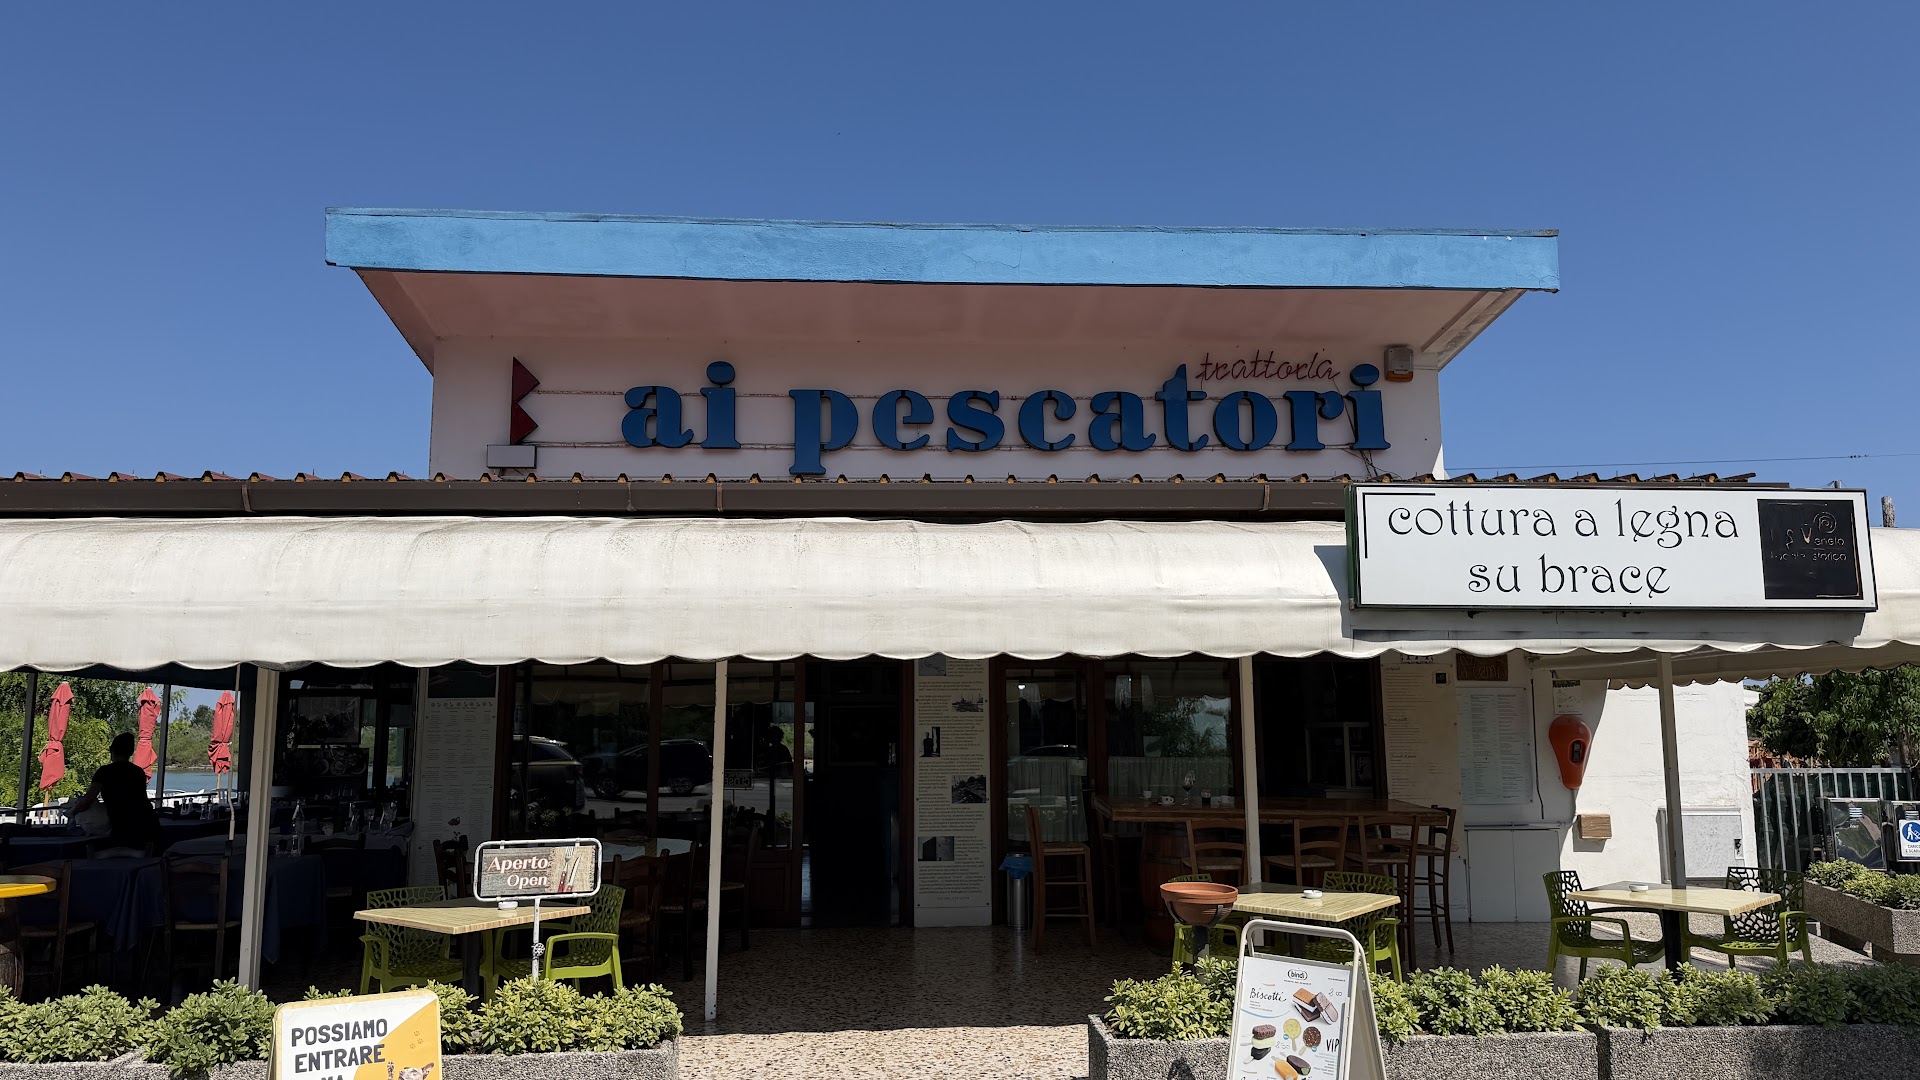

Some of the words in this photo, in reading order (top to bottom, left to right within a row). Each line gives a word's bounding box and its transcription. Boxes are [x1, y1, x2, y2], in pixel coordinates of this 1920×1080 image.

[1195, 350, 1341, 381] trattoria
[621, 360, 741, 449] ai
[789, 363, 1391, 475] pescatori
[1388, 499, 1557, 537] cottura
[1574, 508, 1600, 537] a
[1614, 498, 1739, 549] legna
[1467, 563, 1521, 594] su
[1538, 552, 1671, 598] brace
[487, 855, 549, 874] Aperto
[506, 874, 549, 890] Open
[1290, 970, 1305, 980] bindi
[1249, 987, 1287, 1002] Biscotti
[291, 1018, 388, 1047] POSSIAMO
[1326, 1038, 1340, 1053] VIP
[295, 1043, 386, 1074] ENTRARE
